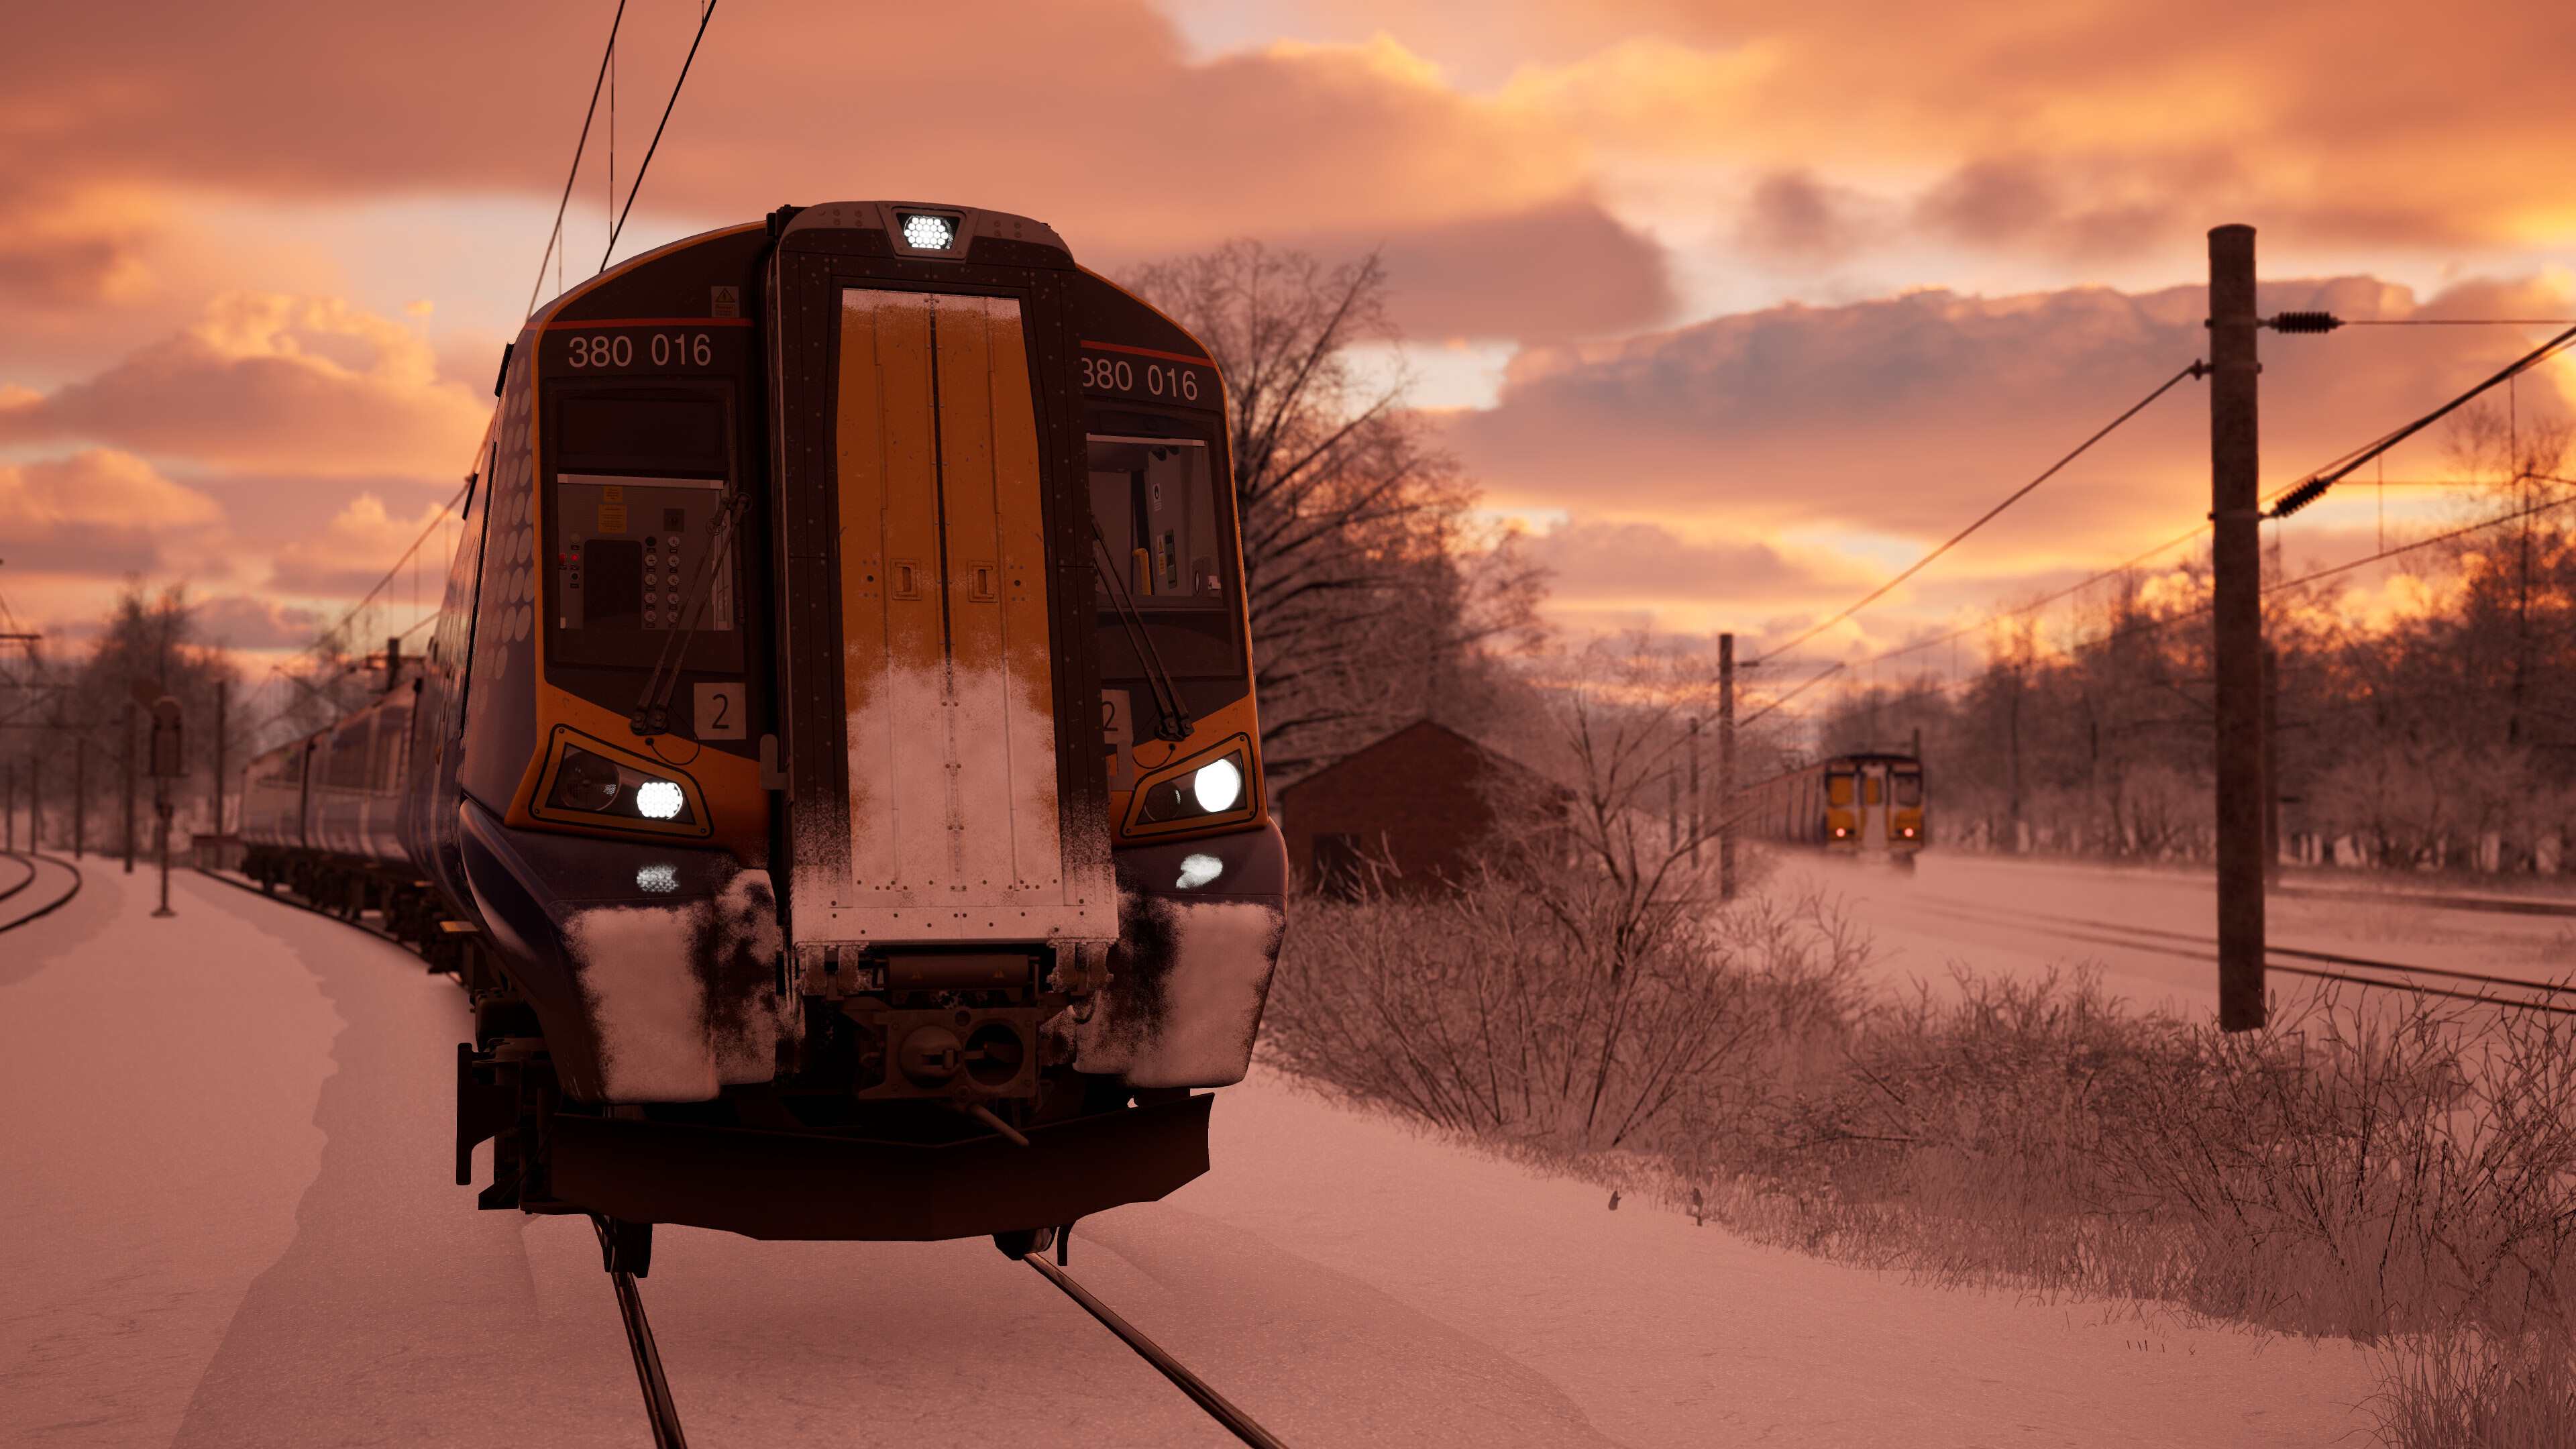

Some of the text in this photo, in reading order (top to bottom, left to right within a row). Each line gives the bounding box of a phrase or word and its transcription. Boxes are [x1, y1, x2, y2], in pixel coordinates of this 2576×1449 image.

[568, 334, 712, 368] 380 016
[1081, 358, 1197, 400] 380 016
[712, 693, 729, 729] 2
[1101, 700, 1118, 732] 2
